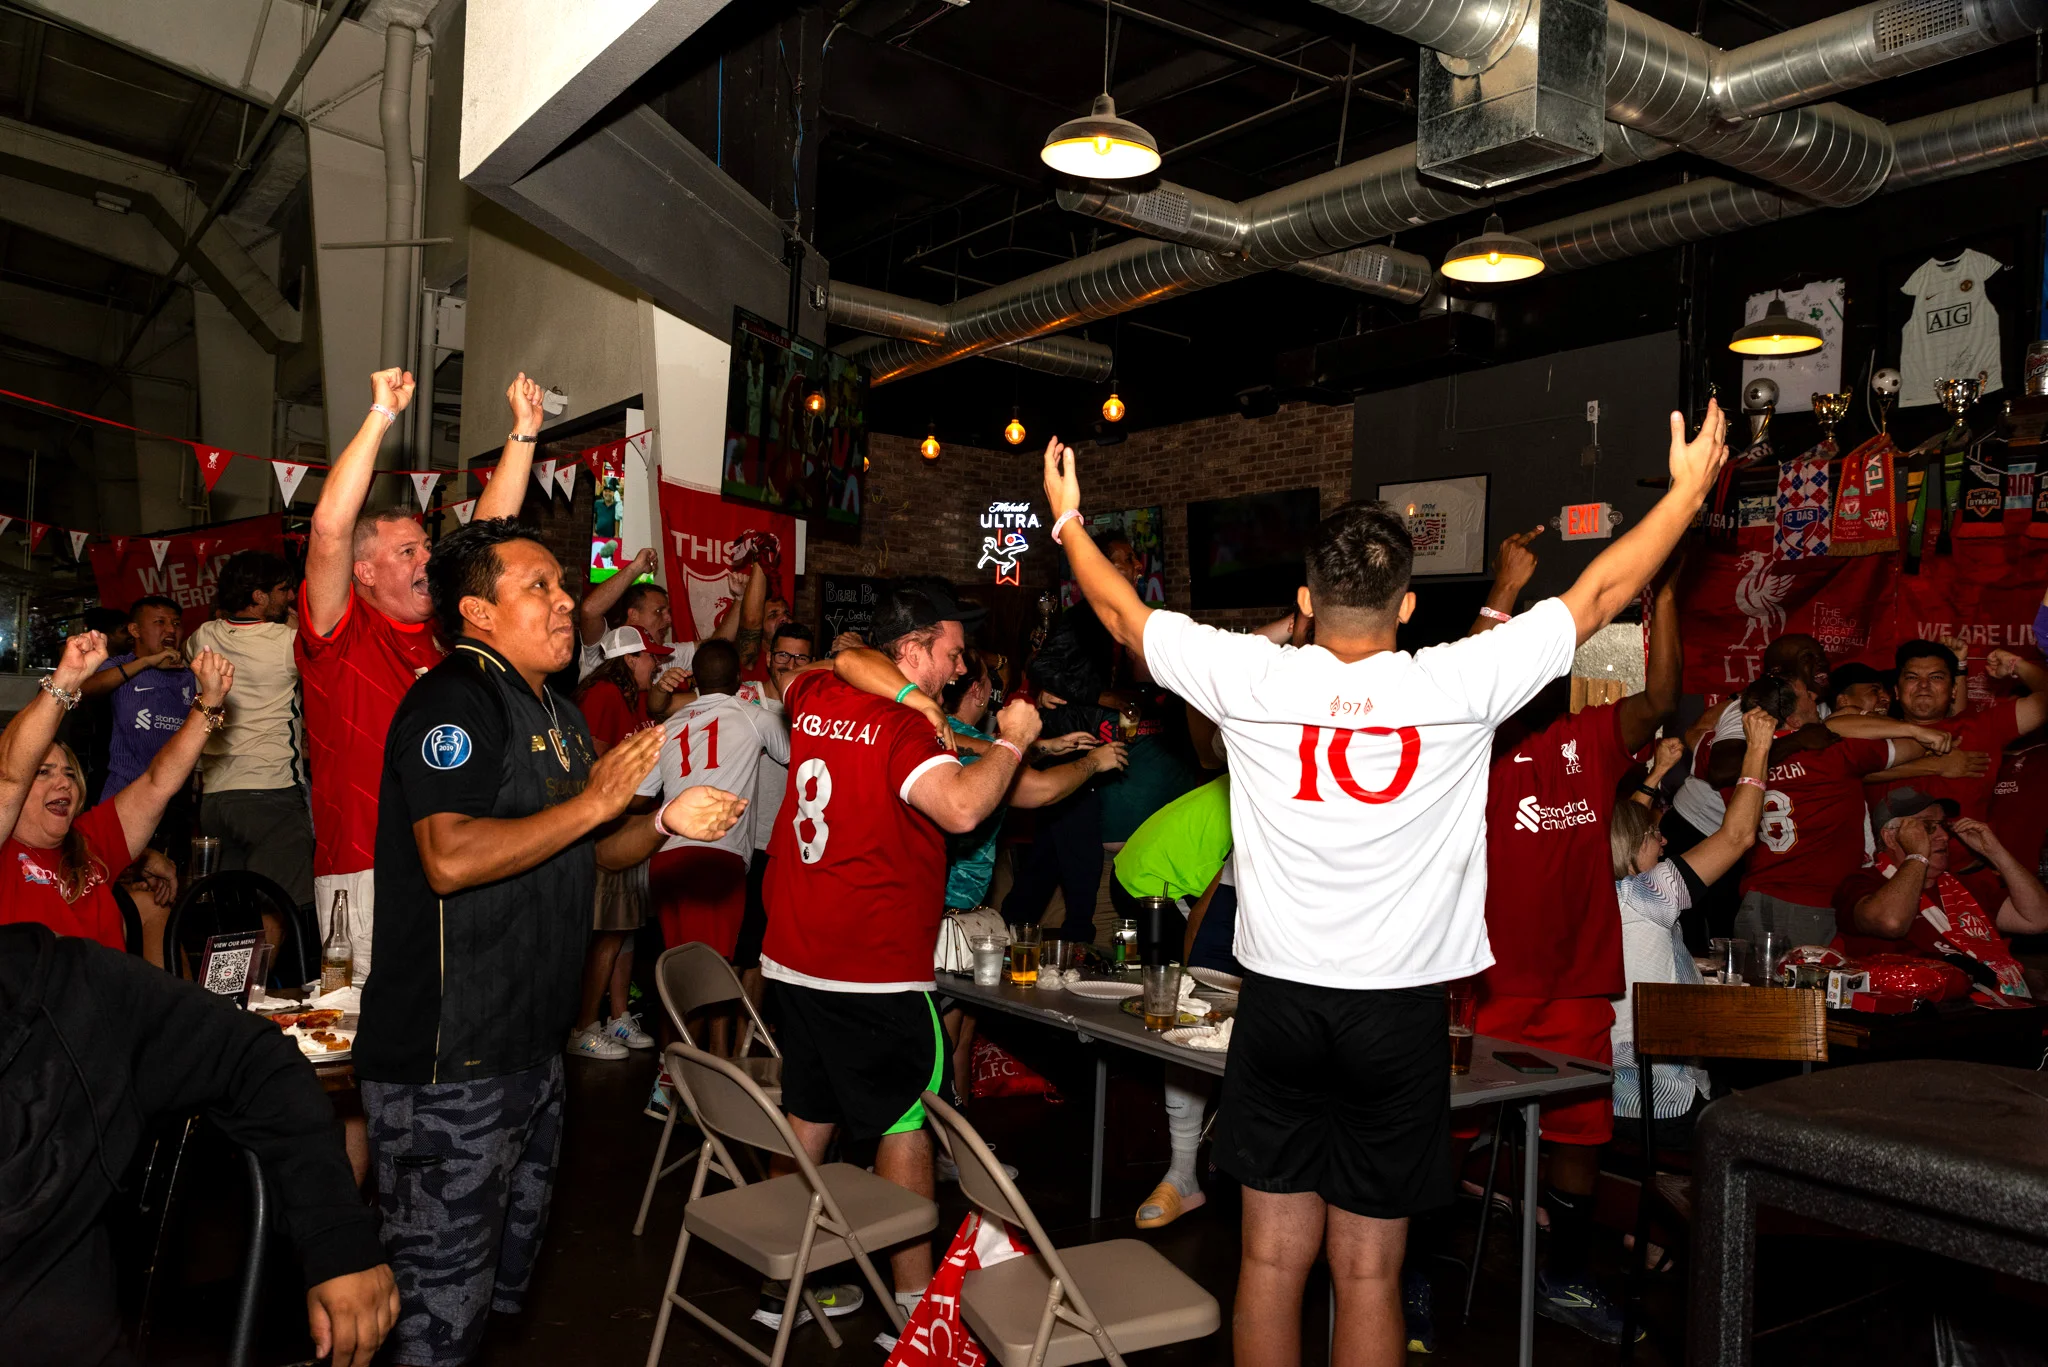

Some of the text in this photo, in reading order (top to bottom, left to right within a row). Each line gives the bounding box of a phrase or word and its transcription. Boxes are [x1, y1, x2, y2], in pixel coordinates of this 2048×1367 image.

[1930, 305, 1969, 330] AIG
[1568, 504, 1600, 535] EXIT
[137, 563, 190, 594] WE
[1820, 607, 1841, 617] THE
[1818, 635, 1864, 646] FOOTBALL
[1917, 621, 1952, 642] WE
[1958, 624, 2000, 645] ARE
[1343, 702, 1361, 715] 97
[672, 717, 720, 778] 11
[1291, 724, 1421, 804] 10
[793, 758, 832, 864] 8
[1758, 790, 1799, 852] 8
